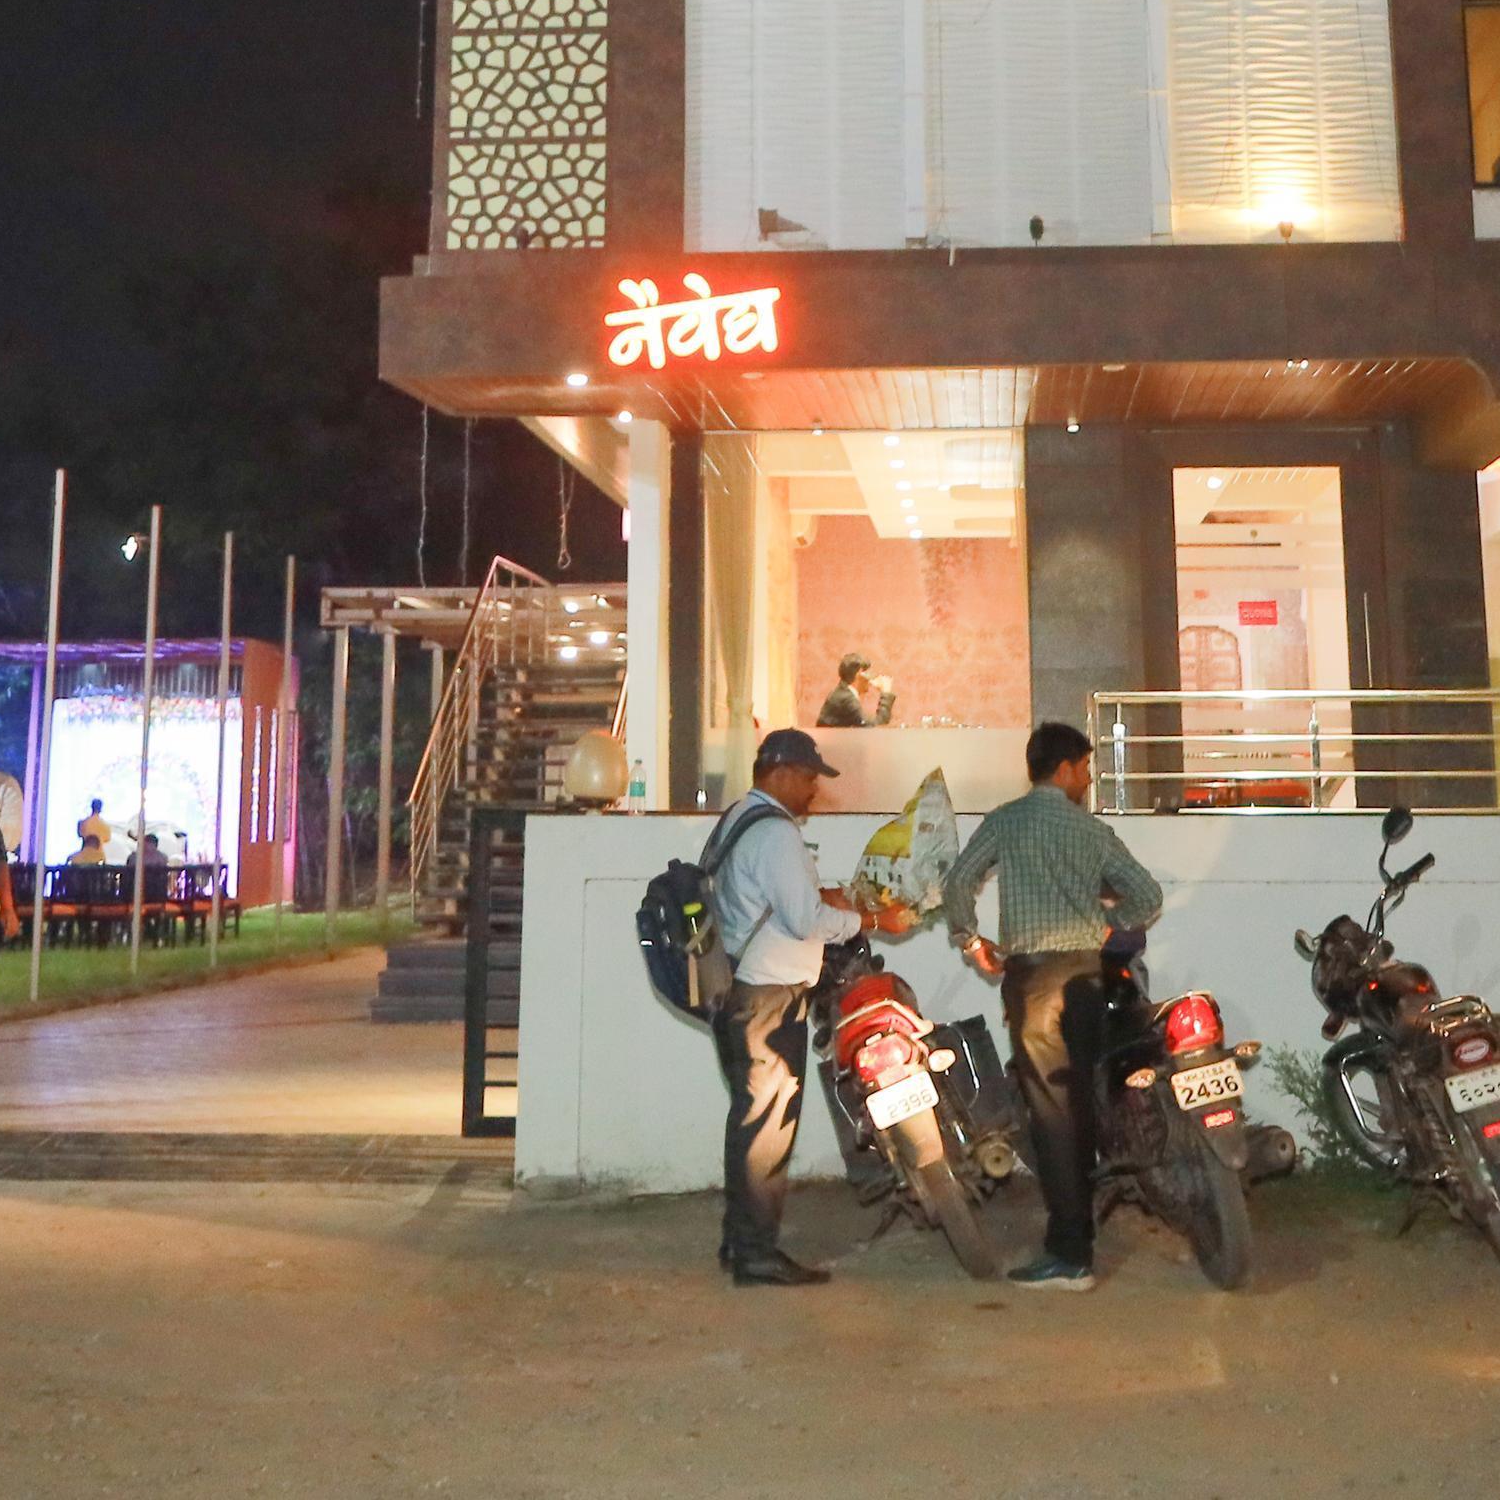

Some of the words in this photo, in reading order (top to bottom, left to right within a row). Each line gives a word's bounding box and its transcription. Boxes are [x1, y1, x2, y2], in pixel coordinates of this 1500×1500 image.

[604, 272, 782, 370] नैवेद्य
[886, 1088, 933, 1119] 2396
[1181, 1075, 1239, 1105] 2436
